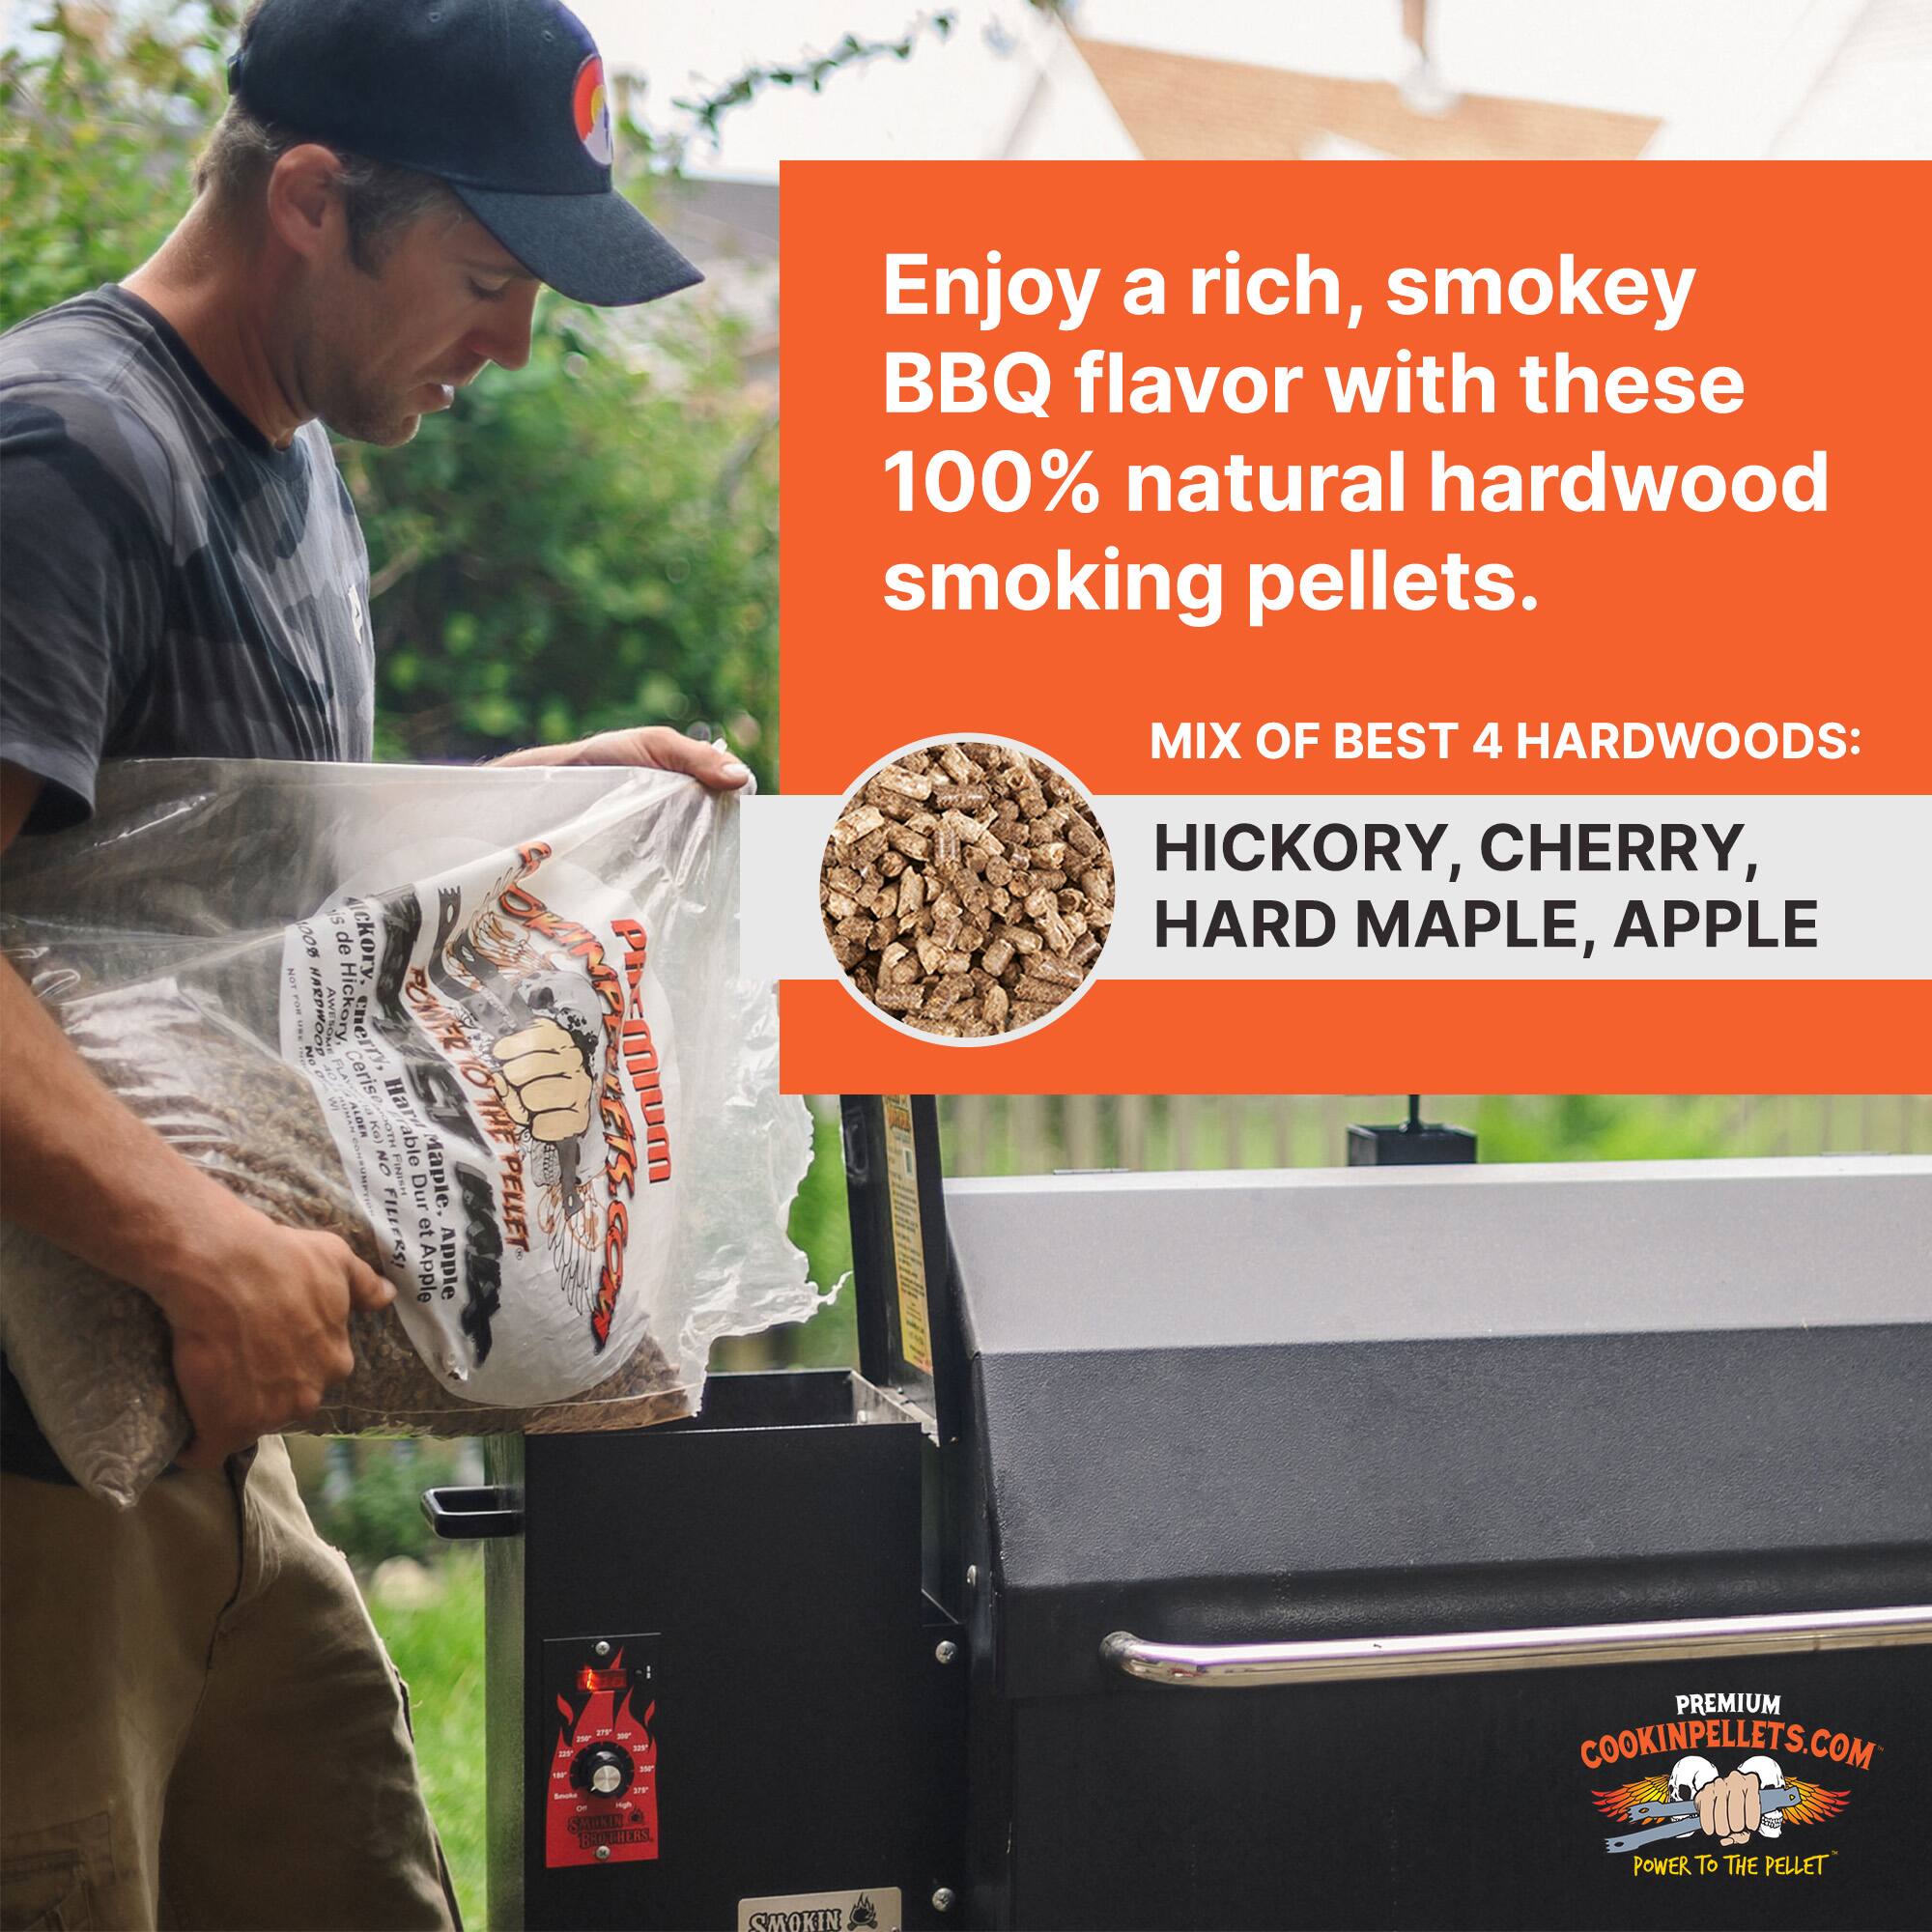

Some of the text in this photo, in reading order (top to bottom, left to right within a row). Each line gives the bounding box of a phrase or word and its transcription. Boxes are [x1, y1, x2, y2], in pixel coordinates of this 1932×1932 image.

[335, 929, 355, 956] de
[334, 962, 358, 1046] Hickory,
[461, 1051, 497, 1094] TO
[308, 966, 327, 1058] HARDWOOD
[375, 1149, 391, 1178] NO
[384, 1187, 407, 1269] FILLERS!
[481, 1094, 520, 1144] THE
[411, 1173, 430, 1212] Dur
[423, 1132, 452, 1218] Maple,
[440, 1226, 459, 1301] Apple
[500, 1147, 530, 1253] PELLET
[417, 1217, 436, 1238] et
[416, 1242, 439, 1304] Apple
